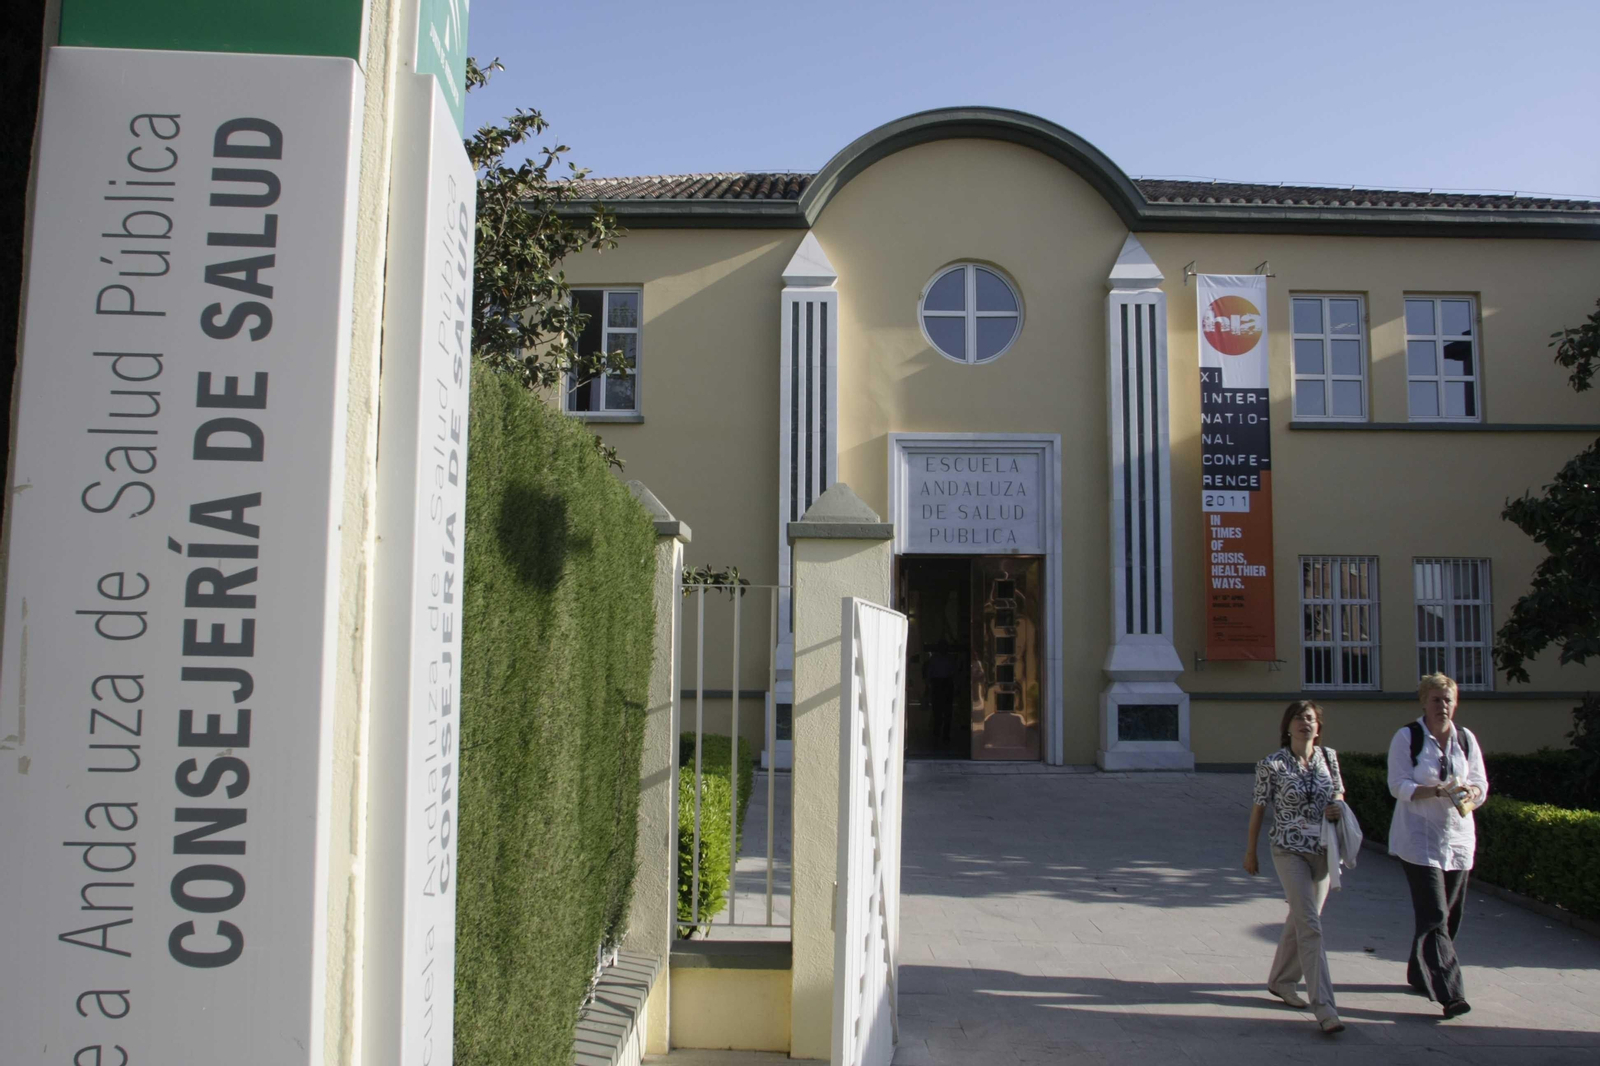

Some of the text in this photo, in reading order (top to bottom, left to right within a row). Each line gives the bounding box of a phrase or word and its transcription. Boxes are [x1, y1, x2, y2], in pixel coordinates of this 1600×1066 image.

[95, 114, 181, 317] Pública
[1200, 371, 1219, 383] XI
[1203, 392, 1268, 405] INTER-
[1201, 413, 1268, 425] NATIO-
[81, 352, 164, 518] Salud
[1201, 433, 1234, 445] NAL
[925, 456, 1020, 473] ESCUELA
[1202, 454, 1270, 466] CONFE-
[1202, 475, 1259, 487] RENCE
[920, 480, 1026, 497] ANDALUZA
[1205, 495, 1248, 507] 2011
[922, 504, 1025, 521] DE SALUD
[1210, 514, 1221, 526] IN
[929, 527, 1017, 544] PUBLICA
[1211, 527, 1242, 539] TIMES
[168, 118, 284, 969] CONSEJERÍA DE SALUD
[438, 201, 469, 896] CONSEJERÍA DE SALUD
[1211, 539, 1224, 551] OF
[1211, 552, 1247, 565] CRISIS,
[1211, 565, 1266, 577] HEALTHIER
[1212, 577, 1245, 589] WAYS.
[75, 572, 150, 641] de
[421, 173, 458, 1066] cuela Andaluza de Salud Pública
